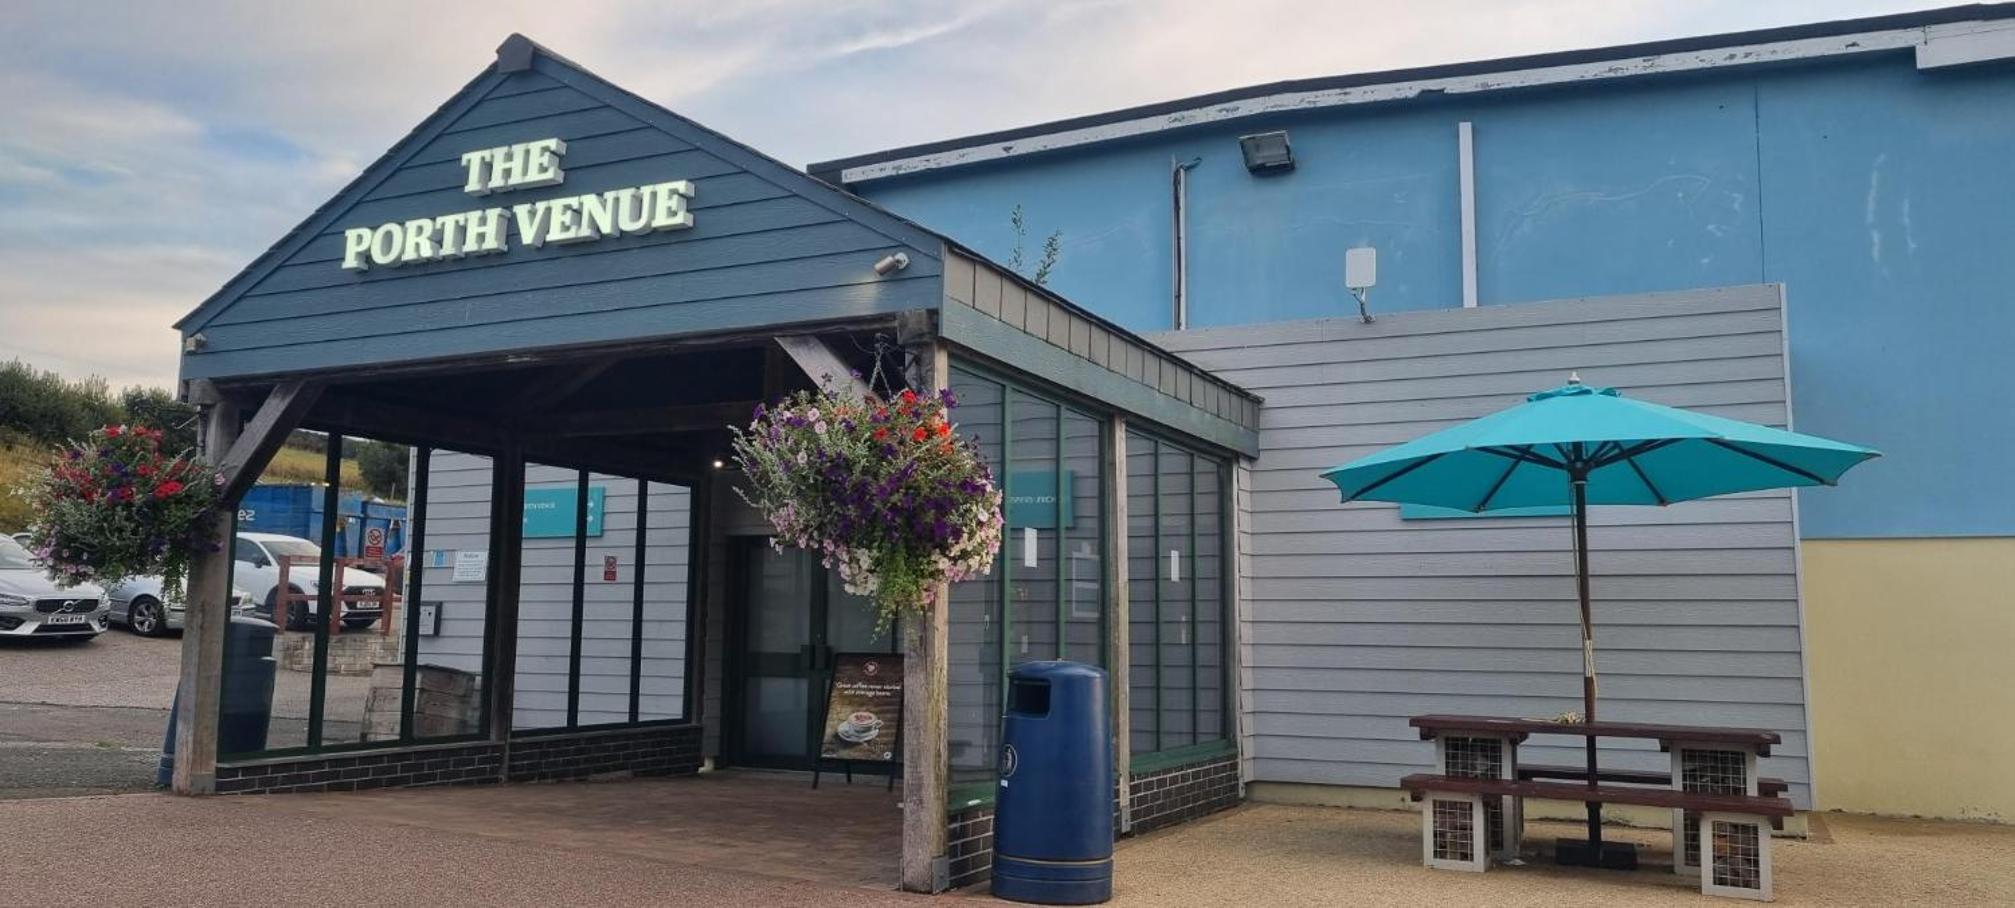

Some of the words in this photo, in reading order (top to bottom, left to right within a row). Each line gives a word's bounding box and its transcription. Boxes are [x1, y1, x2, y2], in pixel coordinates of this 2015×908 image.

[461, 138, 567, 196] THE
[341, 206, 511, 270] PORTH
[513, 180, 695, 248] VENUE
[238, 509, 256, 521] ez
